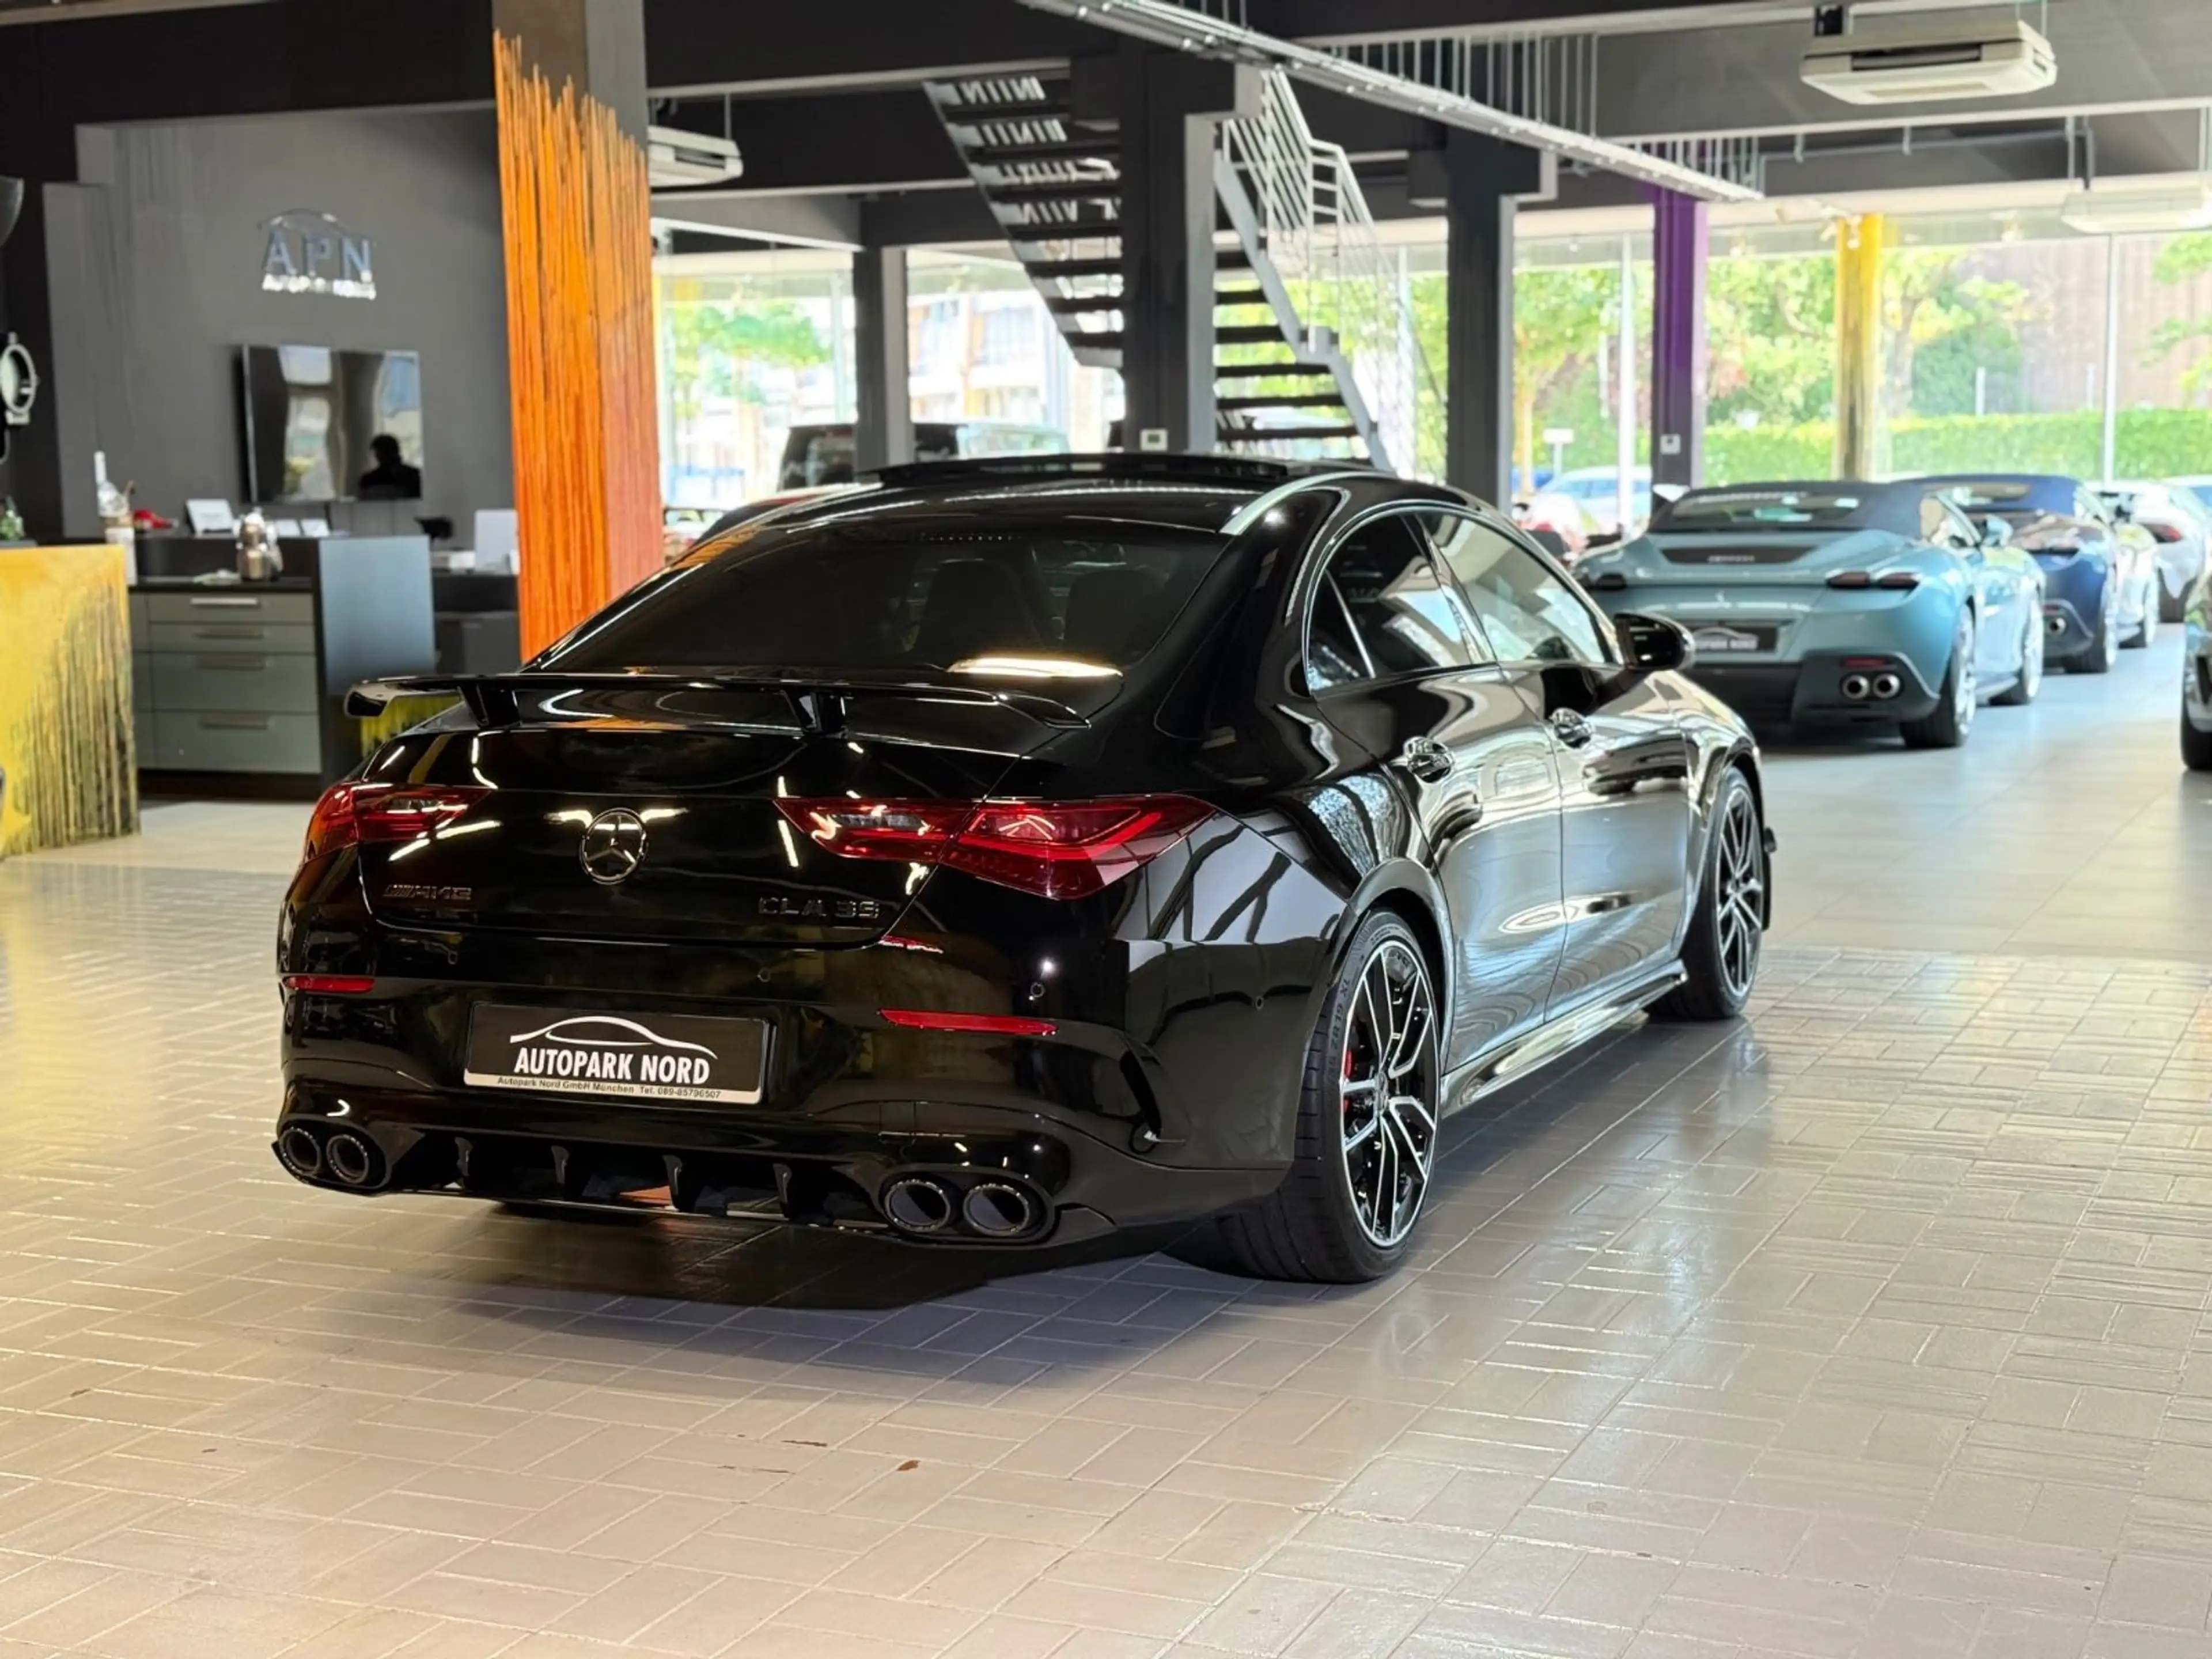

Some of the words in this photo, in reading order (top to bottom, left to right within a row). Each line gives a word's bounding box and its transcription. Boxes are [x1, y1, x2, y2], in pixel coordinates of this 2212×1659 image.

[262, 229, 372, 281] APN
[758, 897, 827, 917] CLA
[514, 1047, 634, 1080] AUTOPARK
[640, 1055, 710, 1085] NORD
[498, 1077, 536, 1086] Autopark
[539, 1079, 560, 1088] Nord
[562, 1081, 590, 1090] GmbH
[593, 1082, 634, 1093] München
[640, 1086, 655, 1094] Tel.
